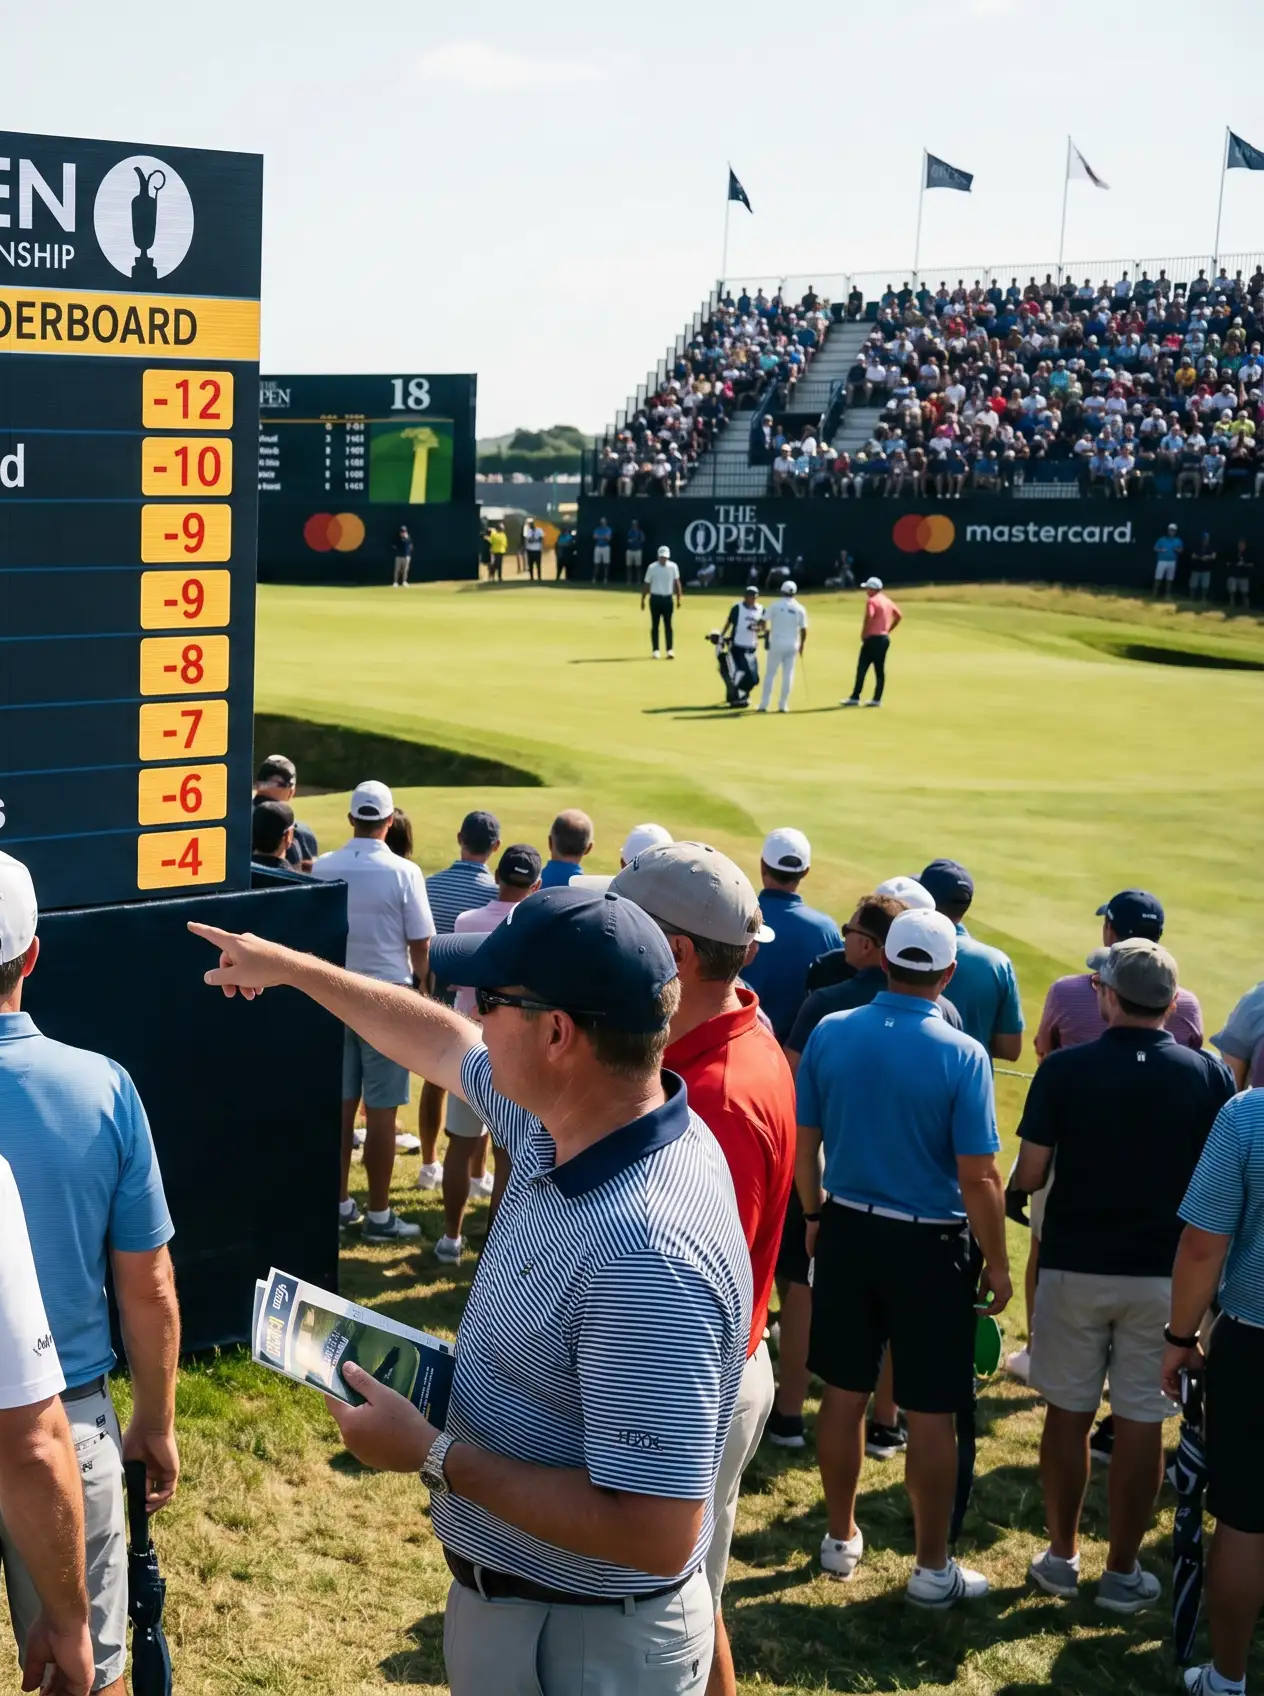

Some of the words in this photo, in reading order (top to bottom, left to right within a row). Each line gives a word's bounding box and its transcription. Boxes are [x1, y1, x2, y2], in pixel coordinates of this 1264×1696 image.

[153, 379, 221, 420] -12
[391, 378, 431, 410] 18
[153, 446, 221, 487] -10
[164, 512, 205, 554] -9
[715, 505, 757, 523] THE
[966, 522, 1133, 543] mastercard
[684, 519, 786, 554] OPEN
[163, 578, 205, 620] -9
[163, 644, 204, 685] -8
[162, 709, 203, 749] -7
[162, 773, 203, 814] -6
[161, 837, 203, 876] -4
